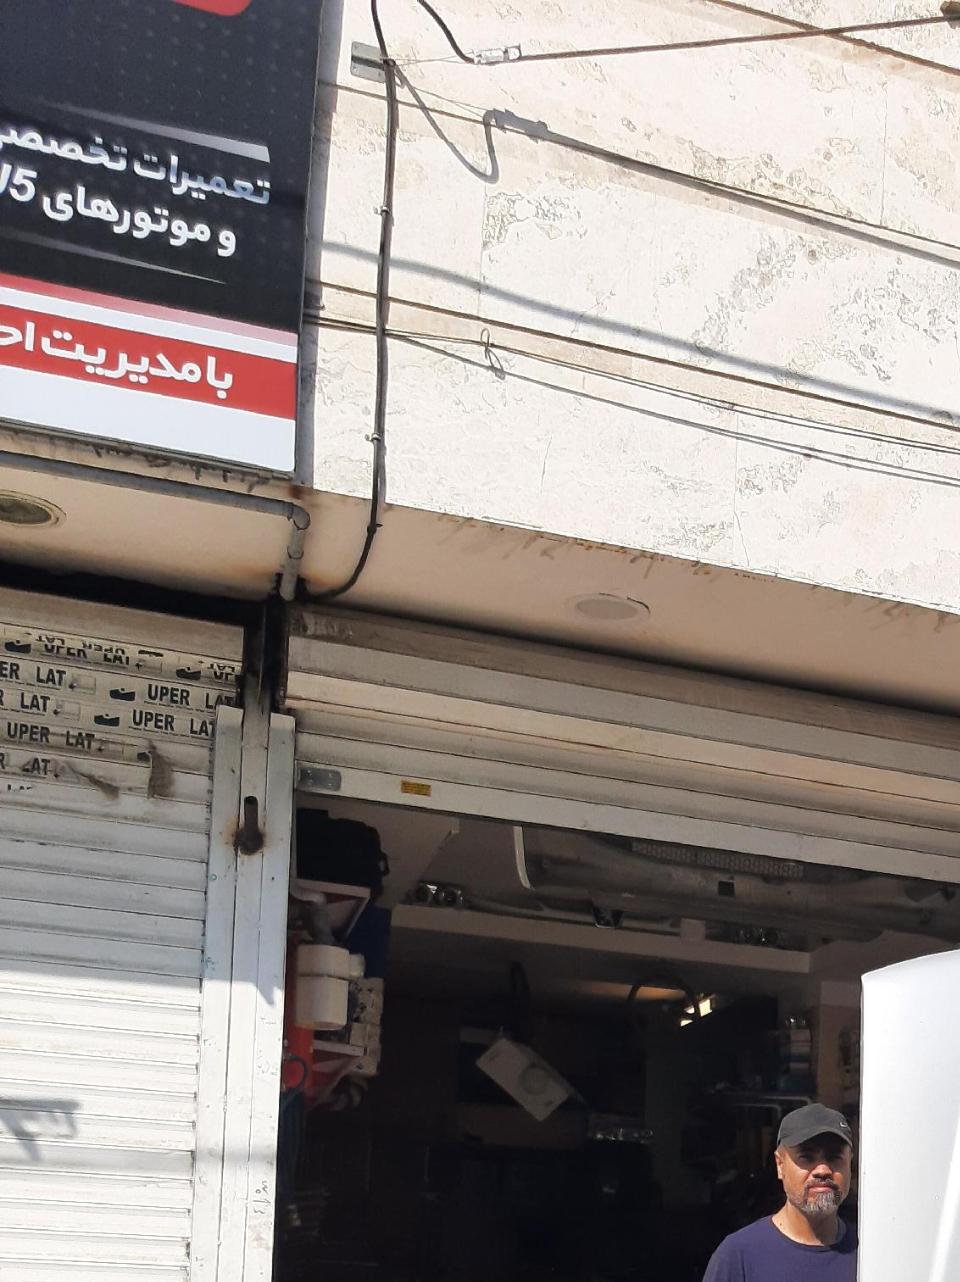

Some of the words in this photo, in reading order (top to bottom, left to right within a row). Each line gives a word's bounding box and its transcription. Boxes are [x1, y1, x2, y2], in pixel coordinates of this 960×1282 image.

[133, 152, 270, 205] تعمیرات
[42, 184, 211, 247] موتورهای
[217, 230, 236, 257] و
[41, 330, 202, 384] مدیریت
[206, 356, 234, 399] با
[36, 666, 66, 686] LAT
[20, 692, 50, 713] LAT
[147, 684, 190, 706] UPER
[132, 709, 175, 732] UPER
[7, 721, 50, 744] UPER
[65, 730, 95, 750] LAT
